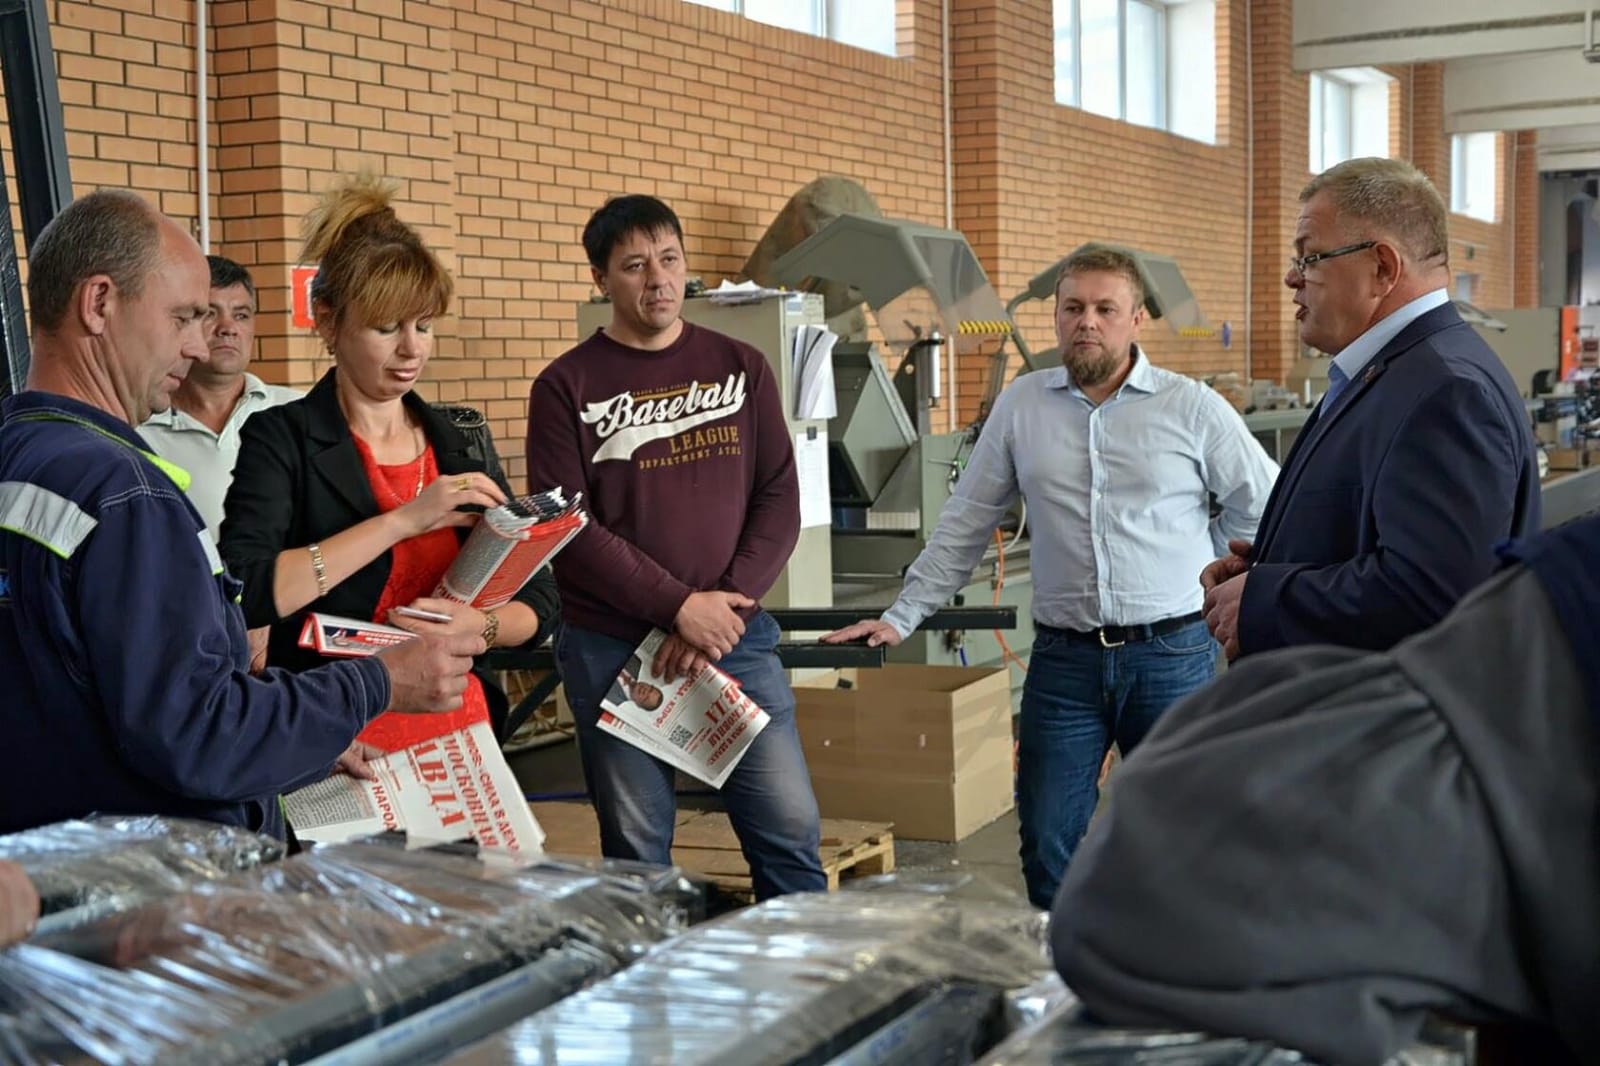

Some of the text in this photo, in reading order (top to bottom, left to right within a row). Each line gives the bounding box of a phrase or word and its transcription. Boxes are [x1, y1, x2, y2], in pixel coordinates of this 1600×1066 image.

[592, 371, 746, 438] Baseball
[669, 425, 740, 454] LEAGUE
[638, 449, 711, 470] DEPARTMENT
